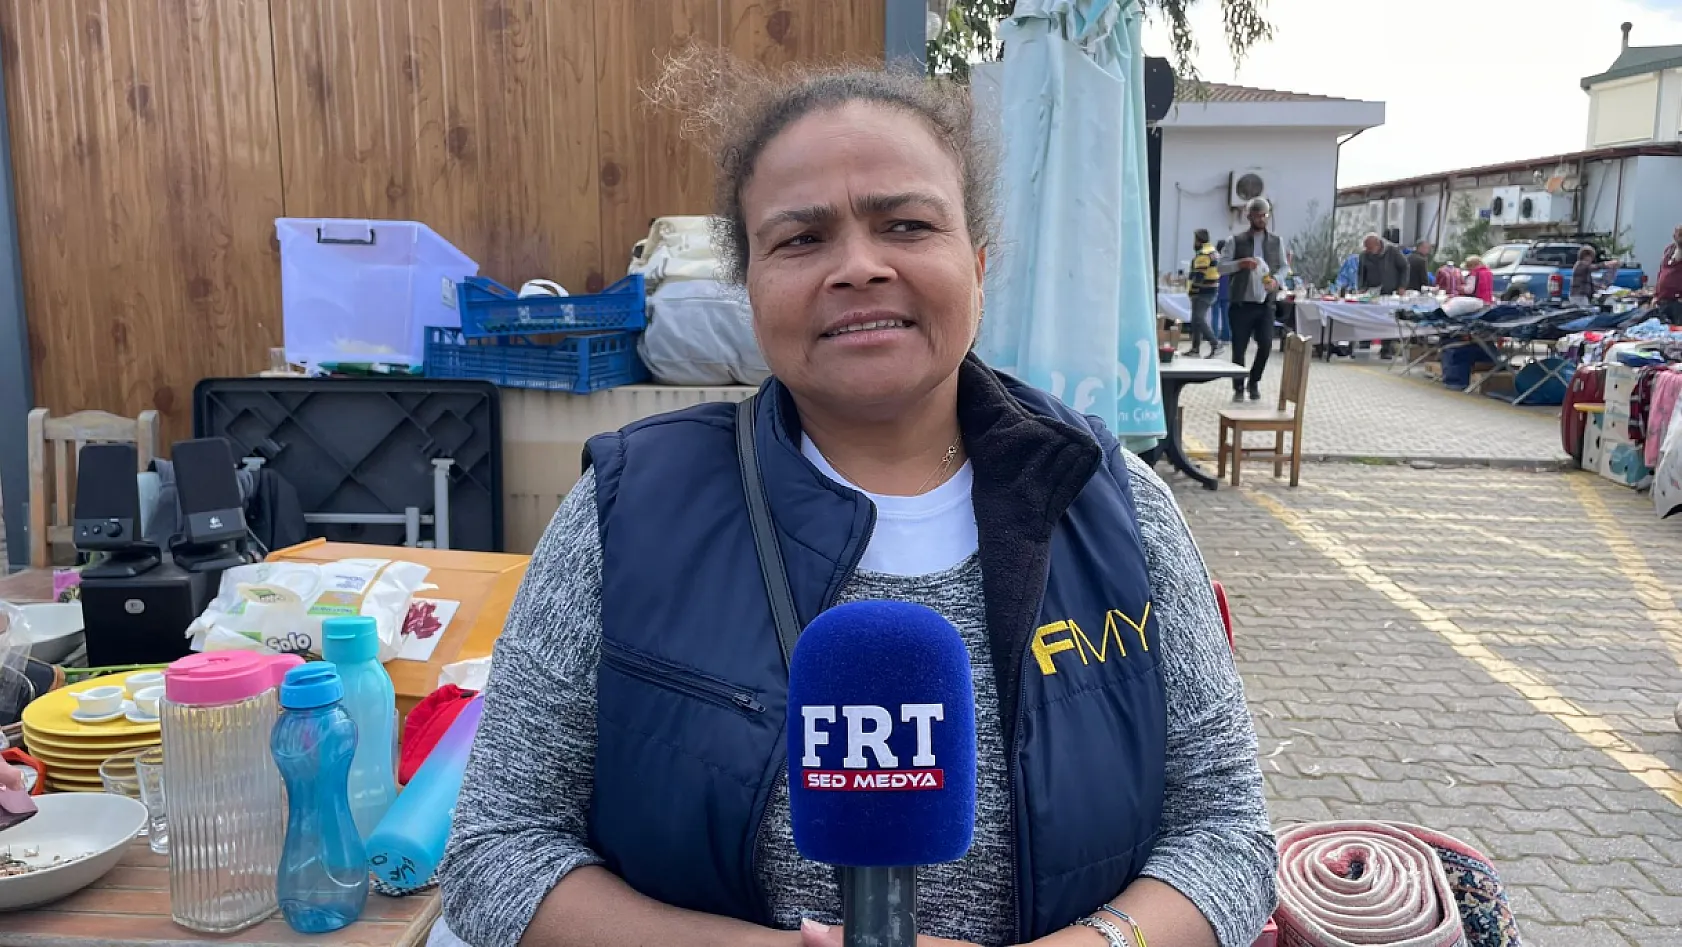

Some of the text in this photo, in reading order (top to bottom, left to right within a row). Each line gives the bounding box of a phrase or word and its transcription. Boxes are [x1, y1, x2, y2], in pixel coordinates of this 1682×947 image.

[266, 631, 312, 653] Solo
[1031, 601, 1150, 676] FMY
[801, 703, 944, 769] FRT
[807, 772, 937, 788] SED MEDYA
